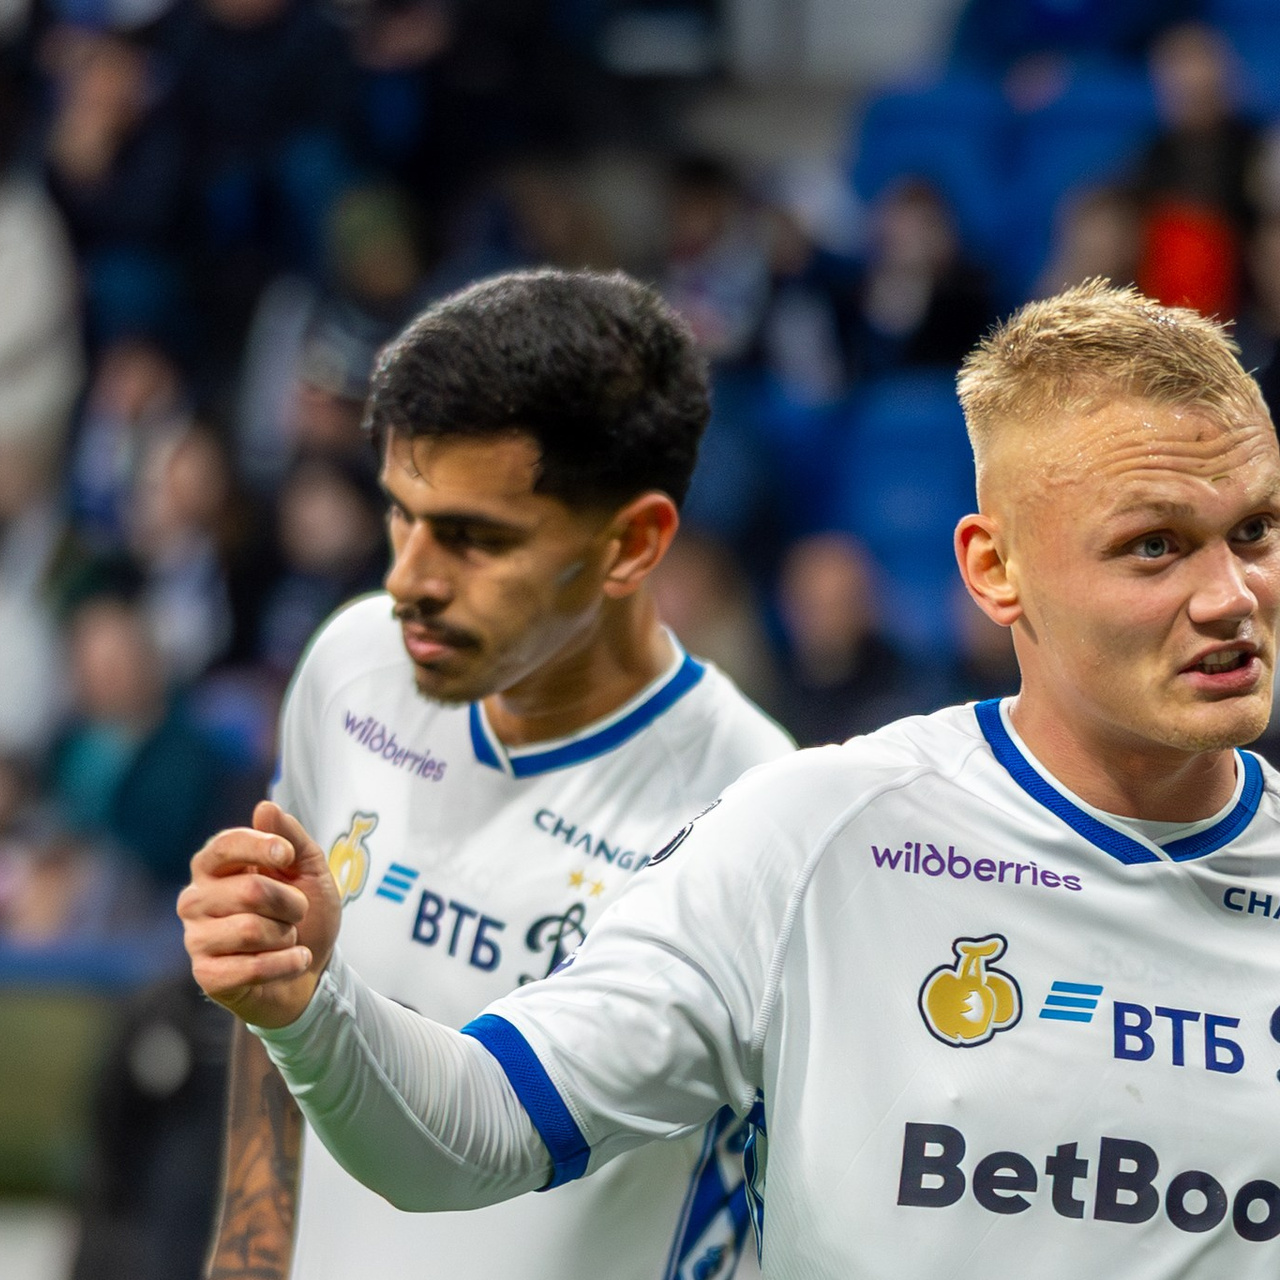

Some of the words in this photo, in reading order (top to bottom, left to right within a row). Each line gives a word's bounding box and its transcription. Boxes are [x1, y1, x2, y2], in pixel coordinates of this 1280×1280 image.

[345, 709, 446, 782] wildberries
[534, 808, 651, 872] CHANG
[871, 841, 1083, 891] wildberries
[411, 889, 506, 972] ВТБ
[1113, 1001, 1245, 1075] ВТБ
